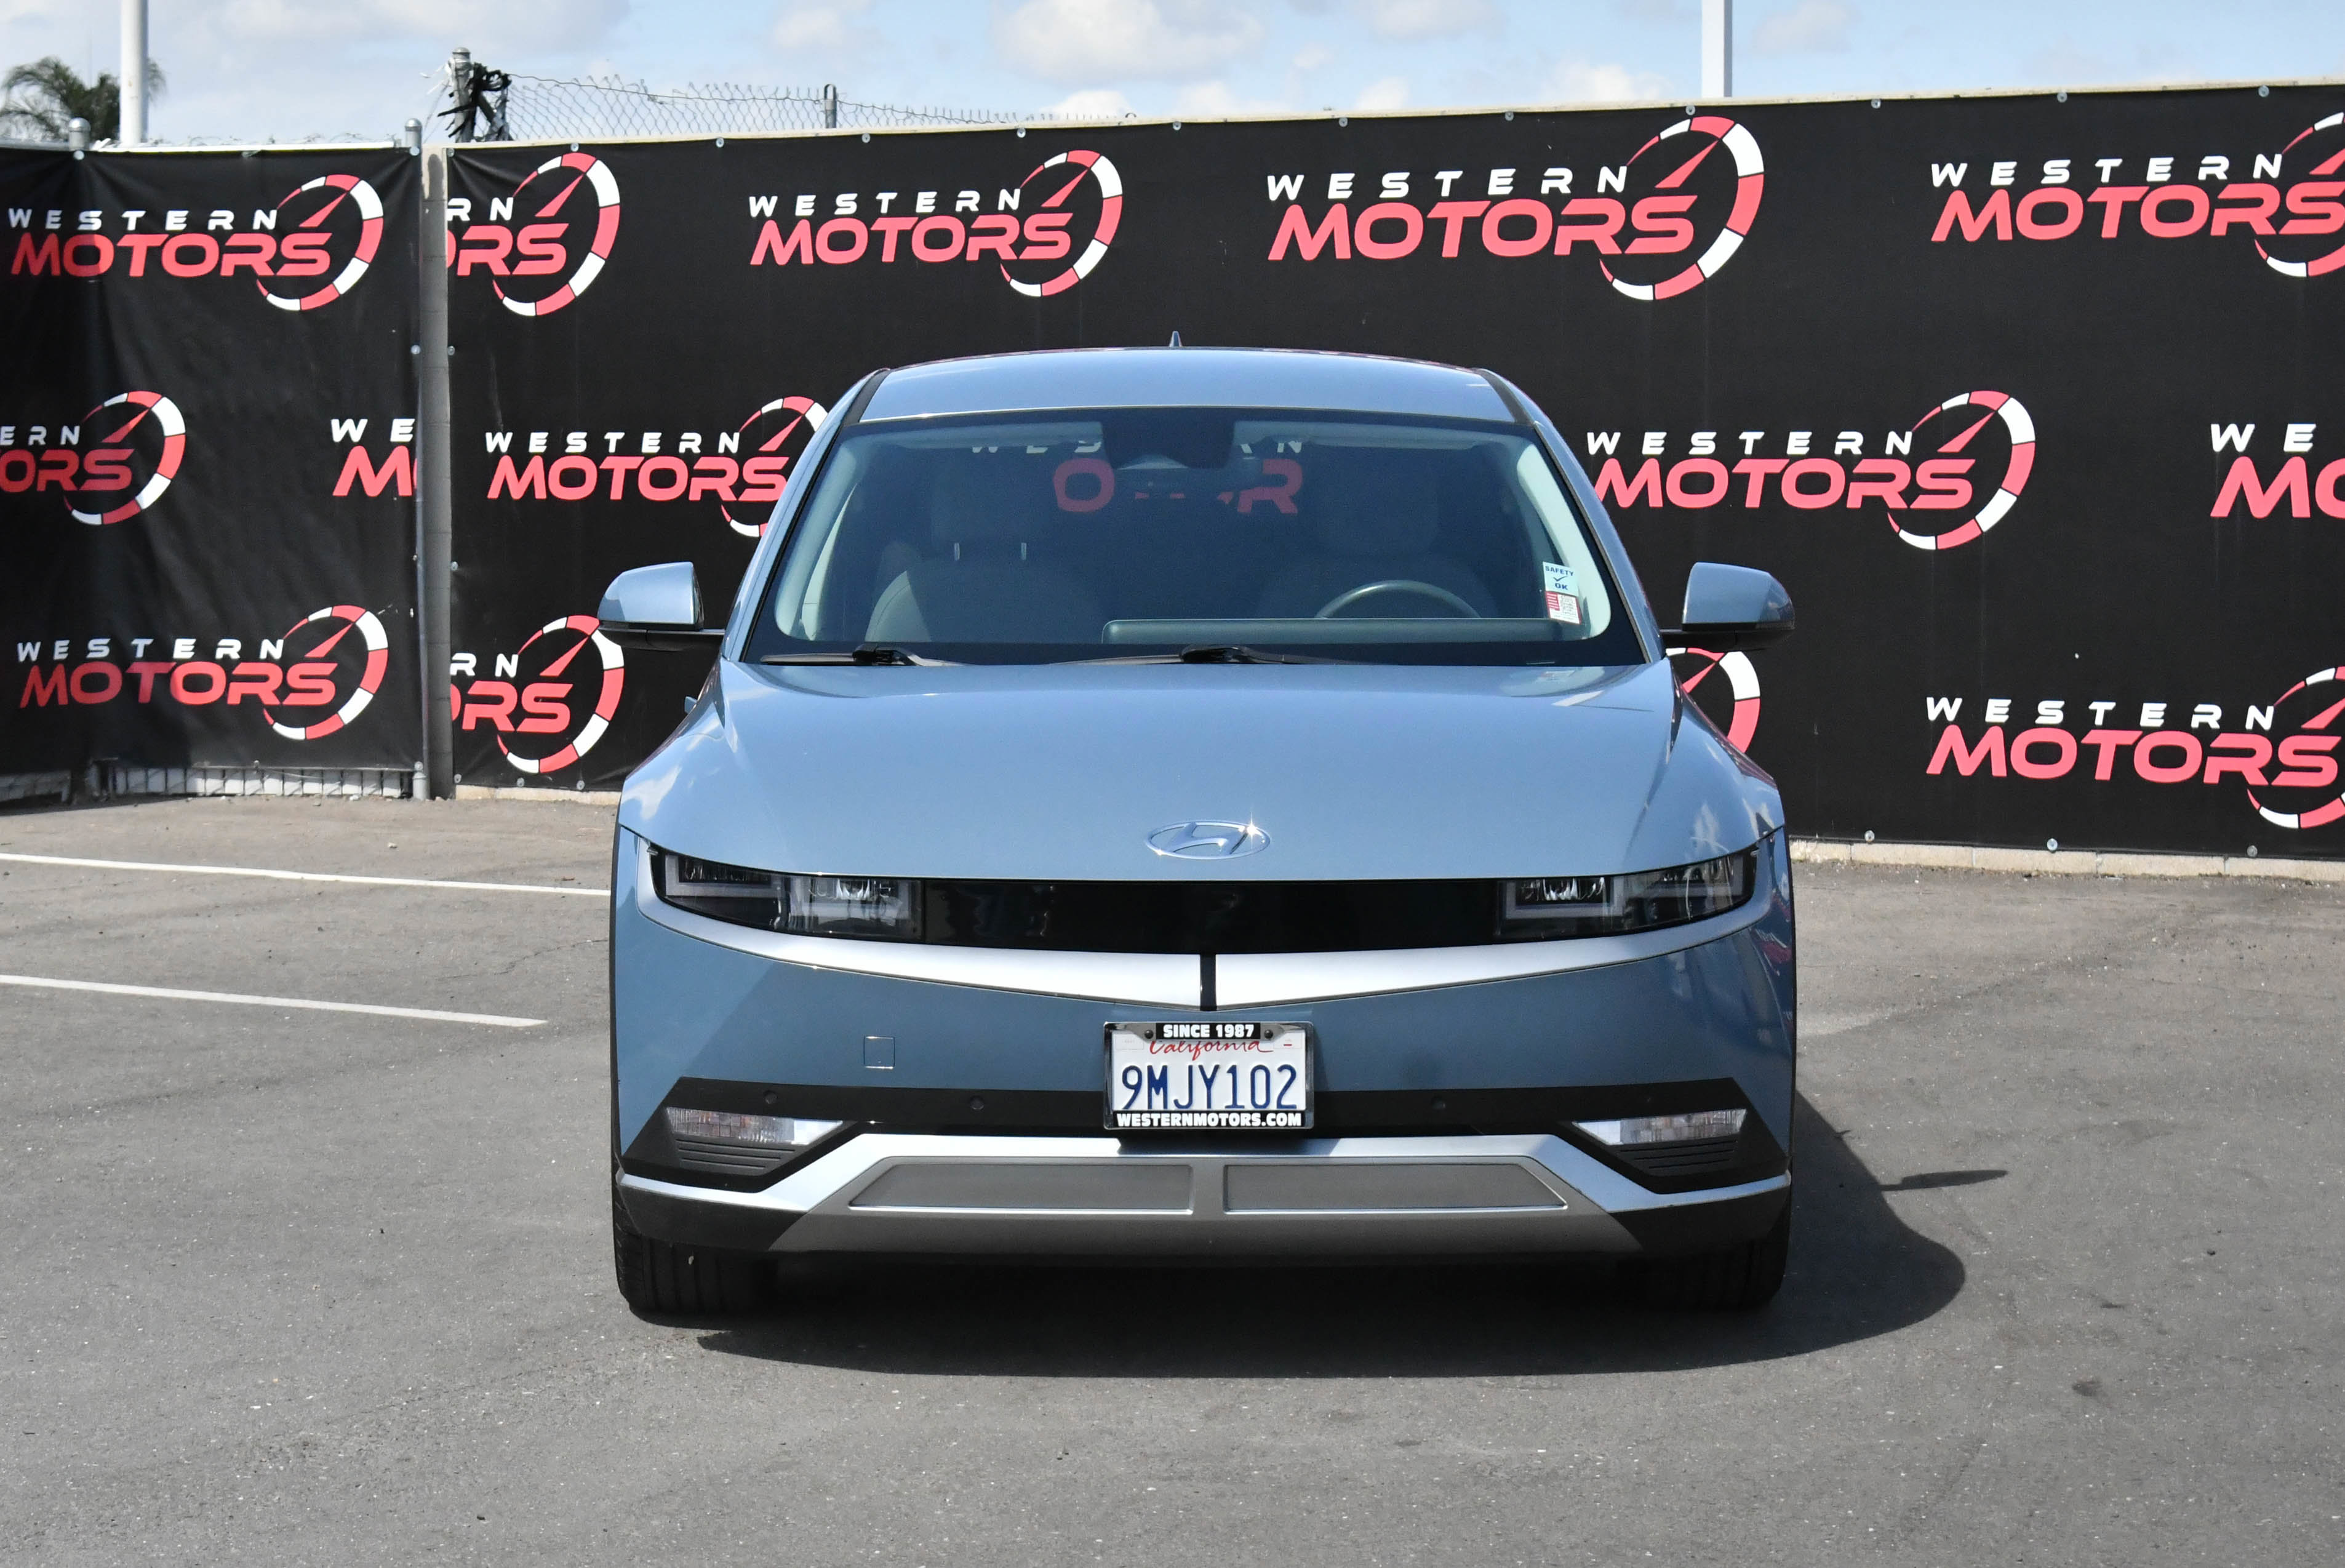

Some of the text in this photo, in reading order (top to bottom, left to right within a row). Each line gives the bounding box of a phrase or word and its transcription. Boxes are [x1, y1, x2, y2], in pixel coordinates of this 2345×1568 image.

[1268, 166, 1628, 201] WESTERN
[1932, 154, 2282, 187] WESTERN
[749, 188, 1020, 217] WESTERN
[1932, 181, 2345, 242] MOTORS
[9, 209, 278, 231] WESTERN
[1268, 194, 1697, 261] MOTORS
[11, 233, 332, 278] MOTORS
[751, 212, 1073, 266] MOTORS
[331, 418, 415, 442] WE
[485, 432, 740, 454] WESTERN
[1587, 431, 1913, 455] WESTERN
[2210, 423, 2317, 453] WE
[487, 455, 789, 502] MOTORS
[1594, 458, 1976, 510] MOTORS
[1545, 566, 1573, 576] SAFETY
[18, 639, 284, 662] WESTERN
[20, 661, 338, 708] MOTORS
[1927, 697, 2275, 731] WESTERN
[1927, 724, 2343, 788] MOTORS
[1163, 1024, 1255, 1038] SINCE 1987
[1149, 1039, 1274, 1061] California
[1122, 1064, 1297, 1110] 9MJY102
[1117, 1113, 1302, 1127] WESTERNMOTORS.COM
